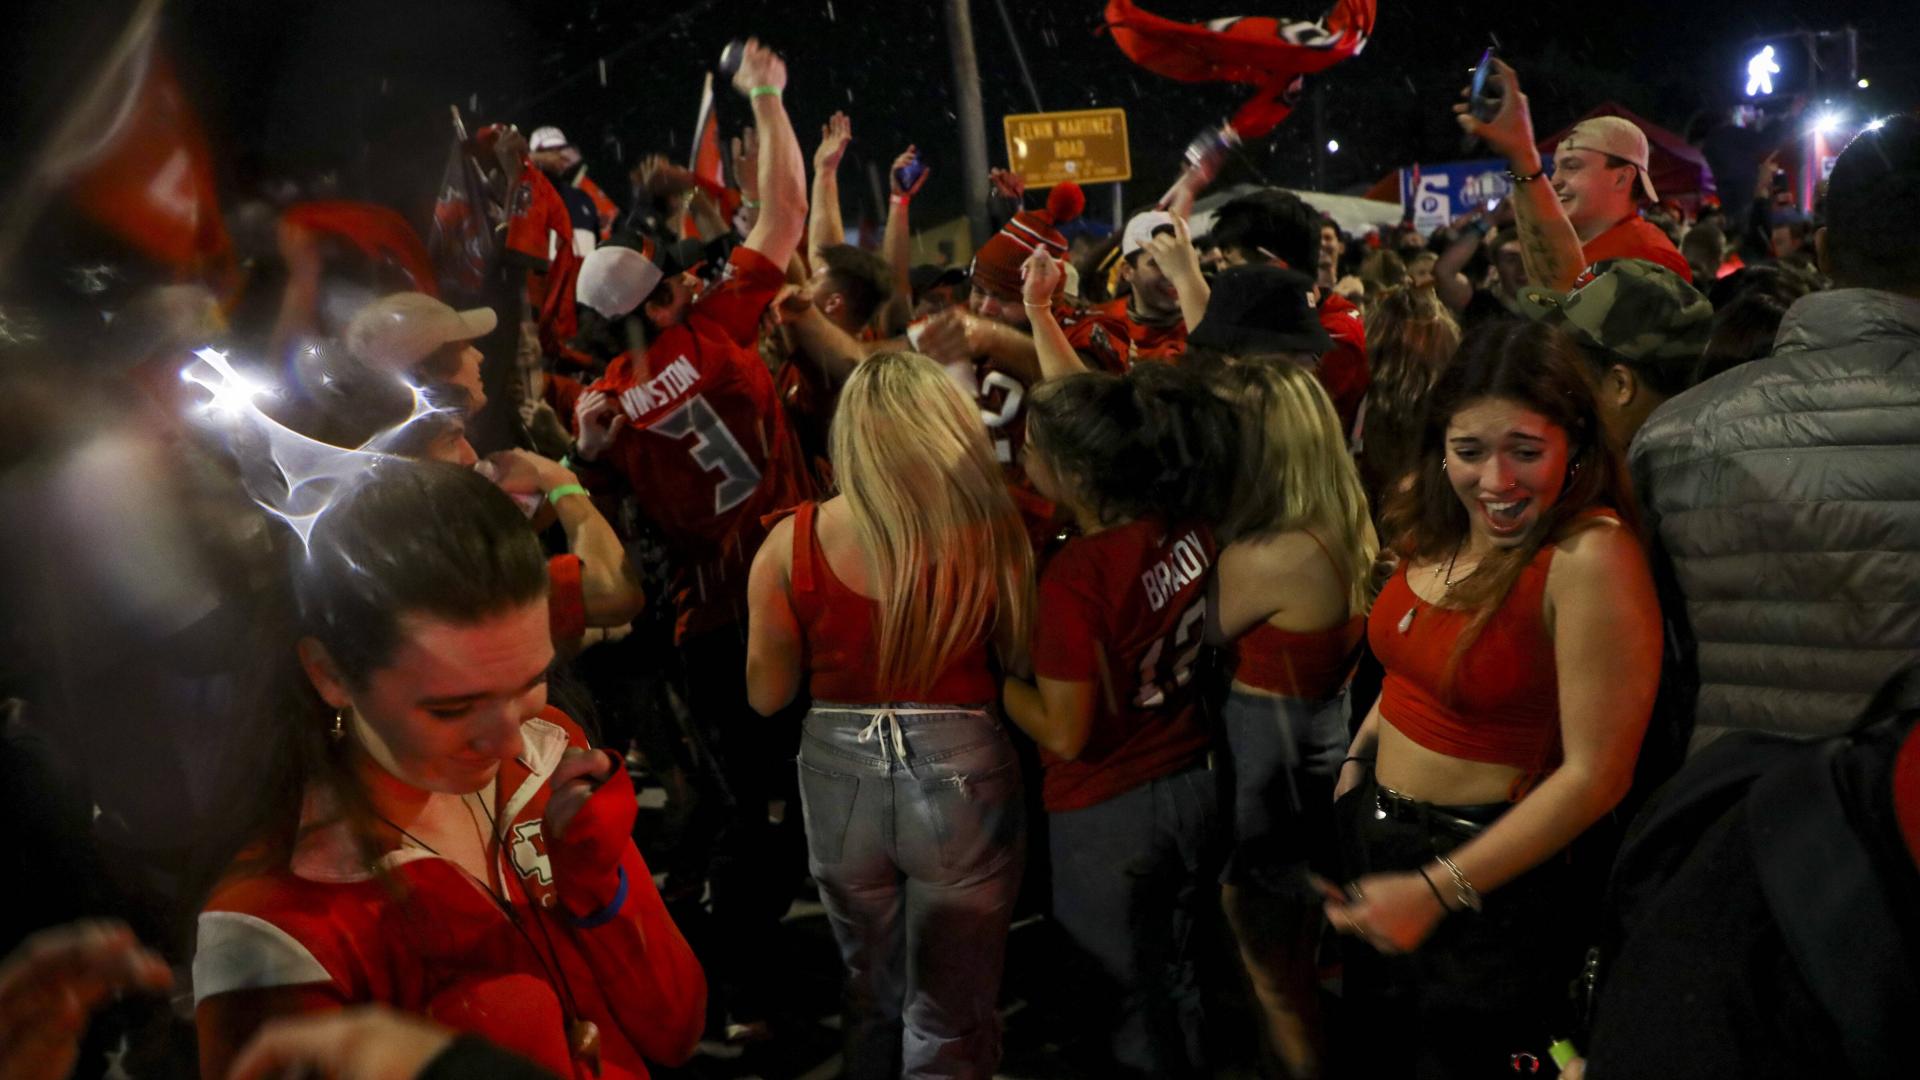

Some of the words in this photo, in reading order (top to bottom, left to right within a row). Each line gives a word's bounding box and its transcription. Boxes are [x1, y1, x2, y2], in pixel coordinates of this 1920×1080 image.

[1054, 139, 1086, 159] ROAD
[1057, 115, 1114, 136] MARTINEZ
[618, 354, 702, 422] WINSTON
[646, 393, 763, 516] 3
[1141, 529, 1210, 613] BRADY
